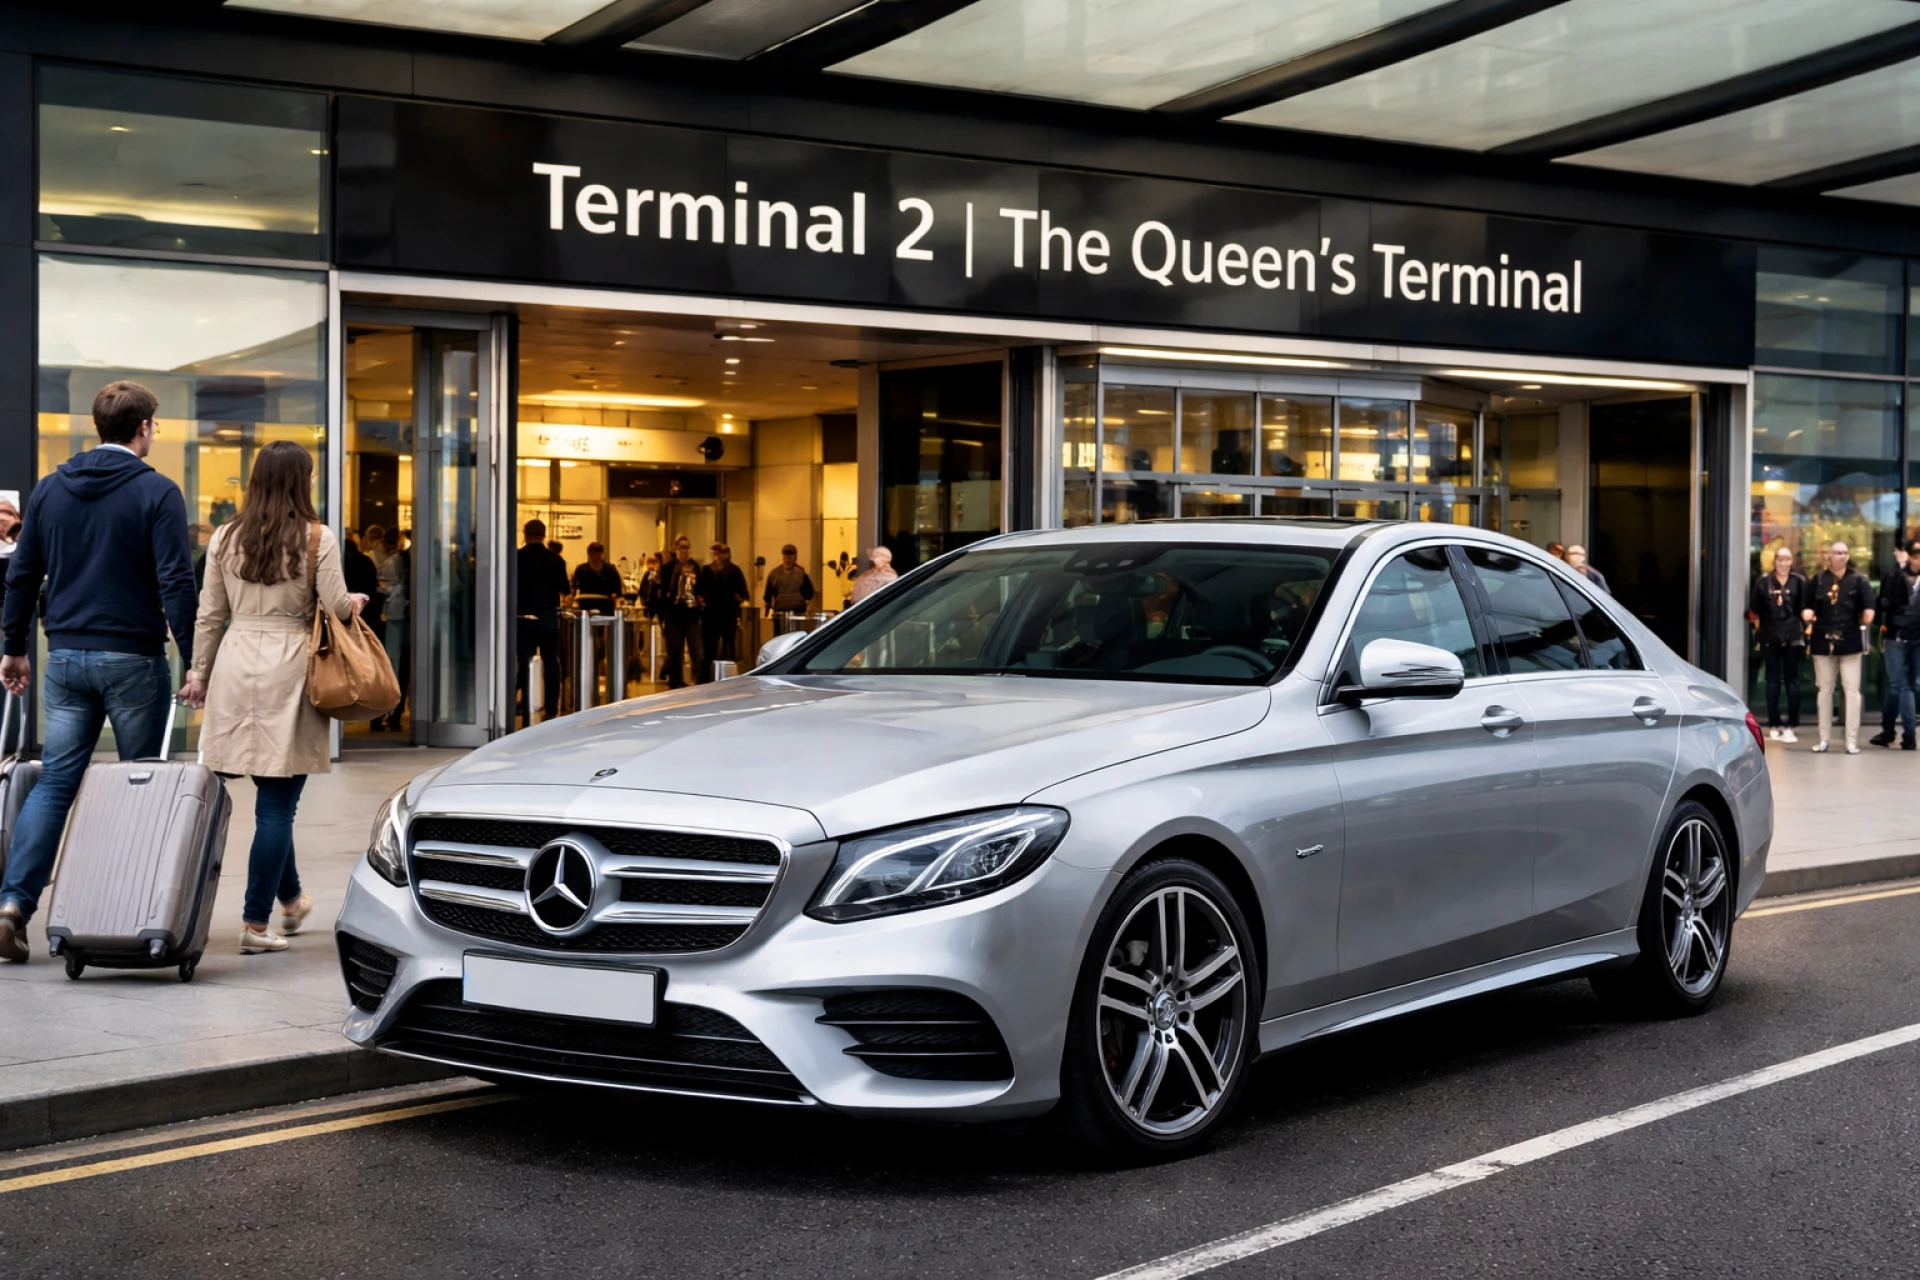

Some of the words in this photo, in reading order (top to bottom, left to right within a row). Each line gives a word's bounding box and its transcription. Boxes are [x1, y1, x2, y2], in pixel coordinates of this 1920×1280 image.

[533, 162, 866, 255] Terminal
[896, 197, 935, 261] 2
[999, 207, 1111, 275] The
[1131, 220, 1356, 295] Queen's
[1372, 243, 1583, 314] Terminal
